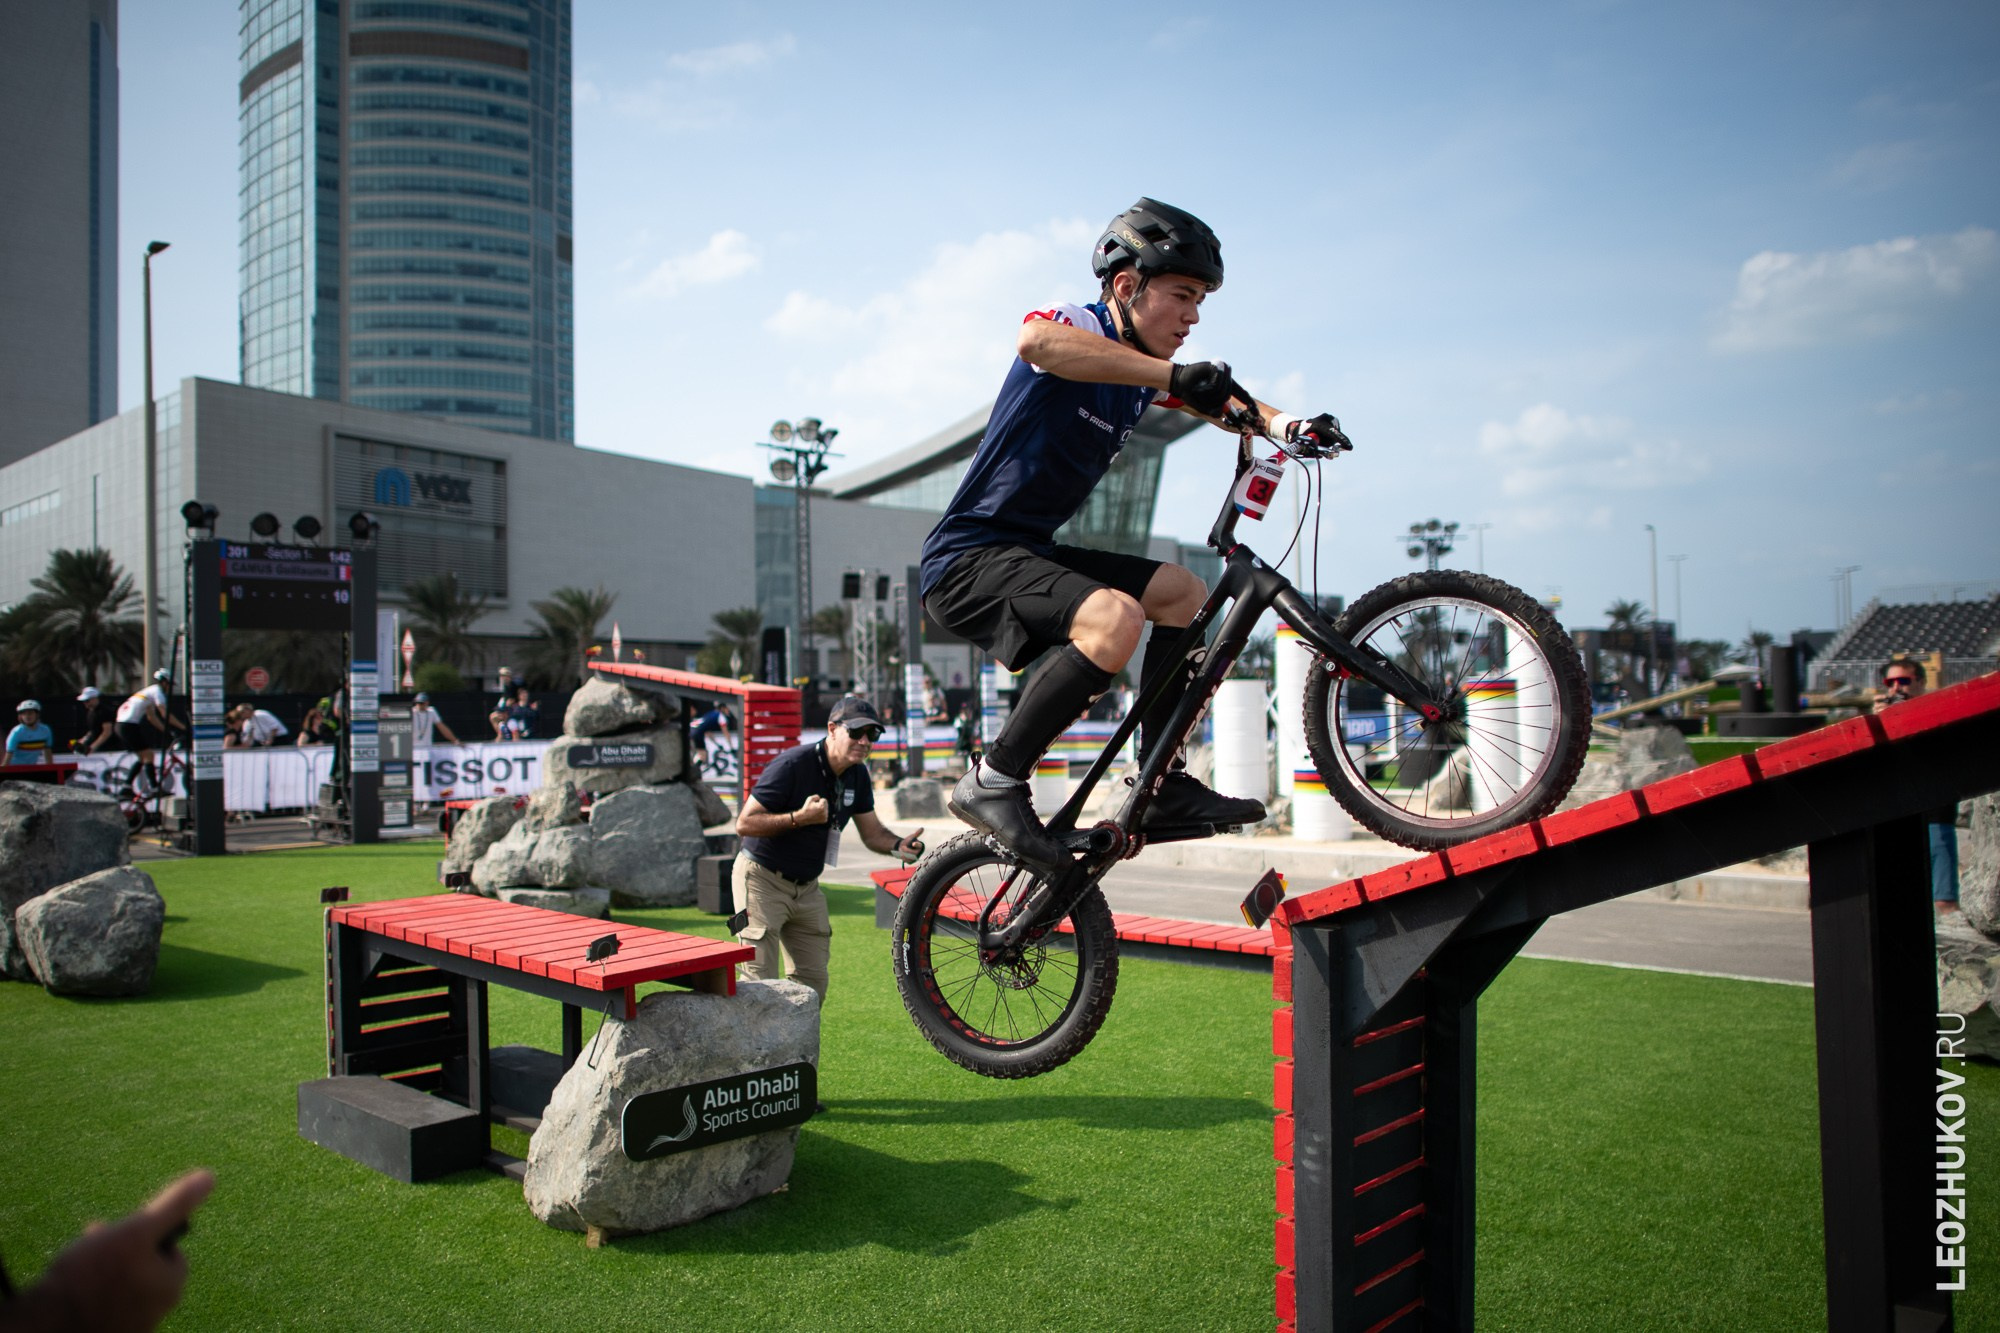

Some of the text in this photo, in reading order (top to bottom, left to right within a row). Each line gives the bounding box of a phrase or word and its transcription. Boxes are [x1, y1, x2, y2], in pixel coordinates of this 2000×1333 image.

[413, 472, 472, 503] VOX
[1252, 480, 1270, 501] 3
[227, 546, 248, 558] 301
[231, 585, 349, 604] 10 10
[378, 723, 412, 733] FINISH
[389, 734, 400, 759] 1
[601, 744, 646, 755] Abu Dhabi
[703, 1070, 799, 1111] Abu Dhabi
[702, 1093, 800, 1132] Sports Council
